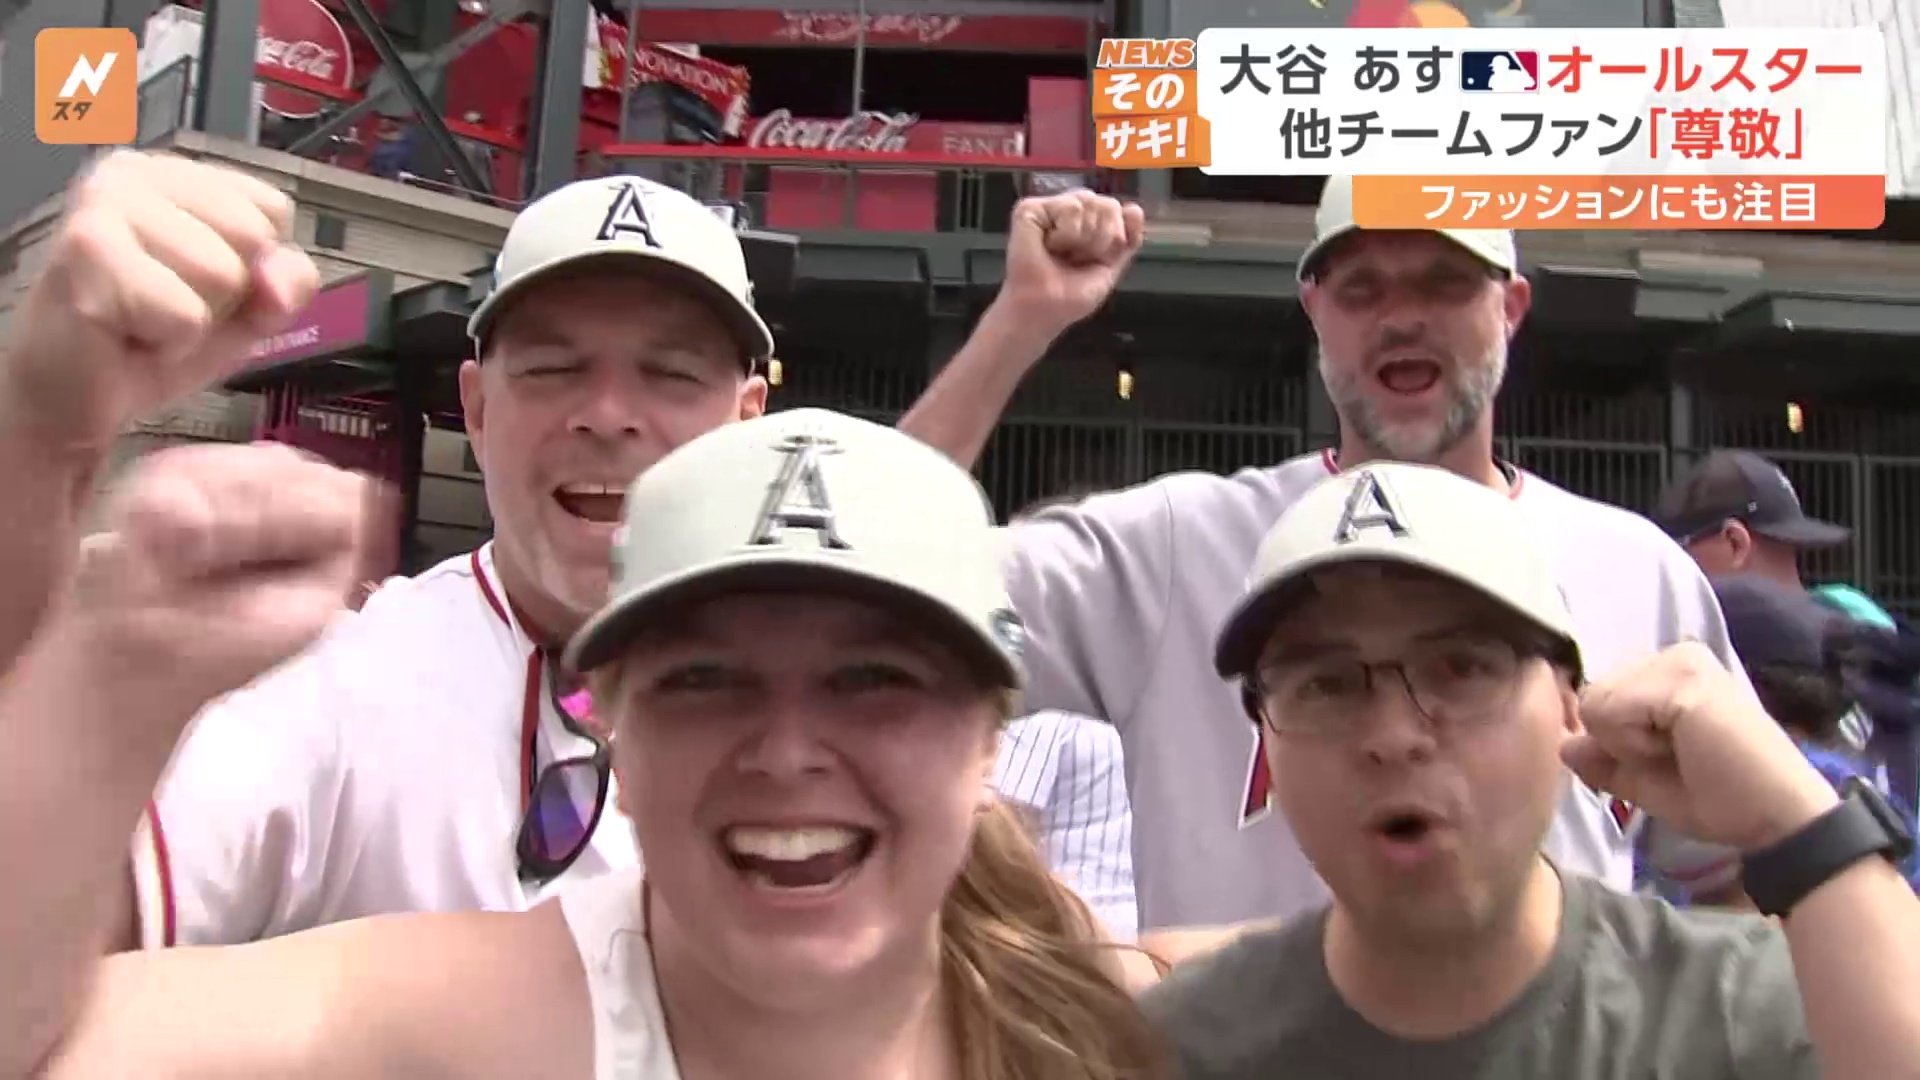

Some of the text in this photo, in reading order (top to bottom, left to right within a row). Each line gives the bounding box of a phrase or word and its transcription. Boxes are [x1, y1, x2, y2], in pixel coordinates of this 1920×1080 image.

[595, 181, 663, 249] A
[745, 436, 855, 550] A
[1333, 469, 1412, 545] A
